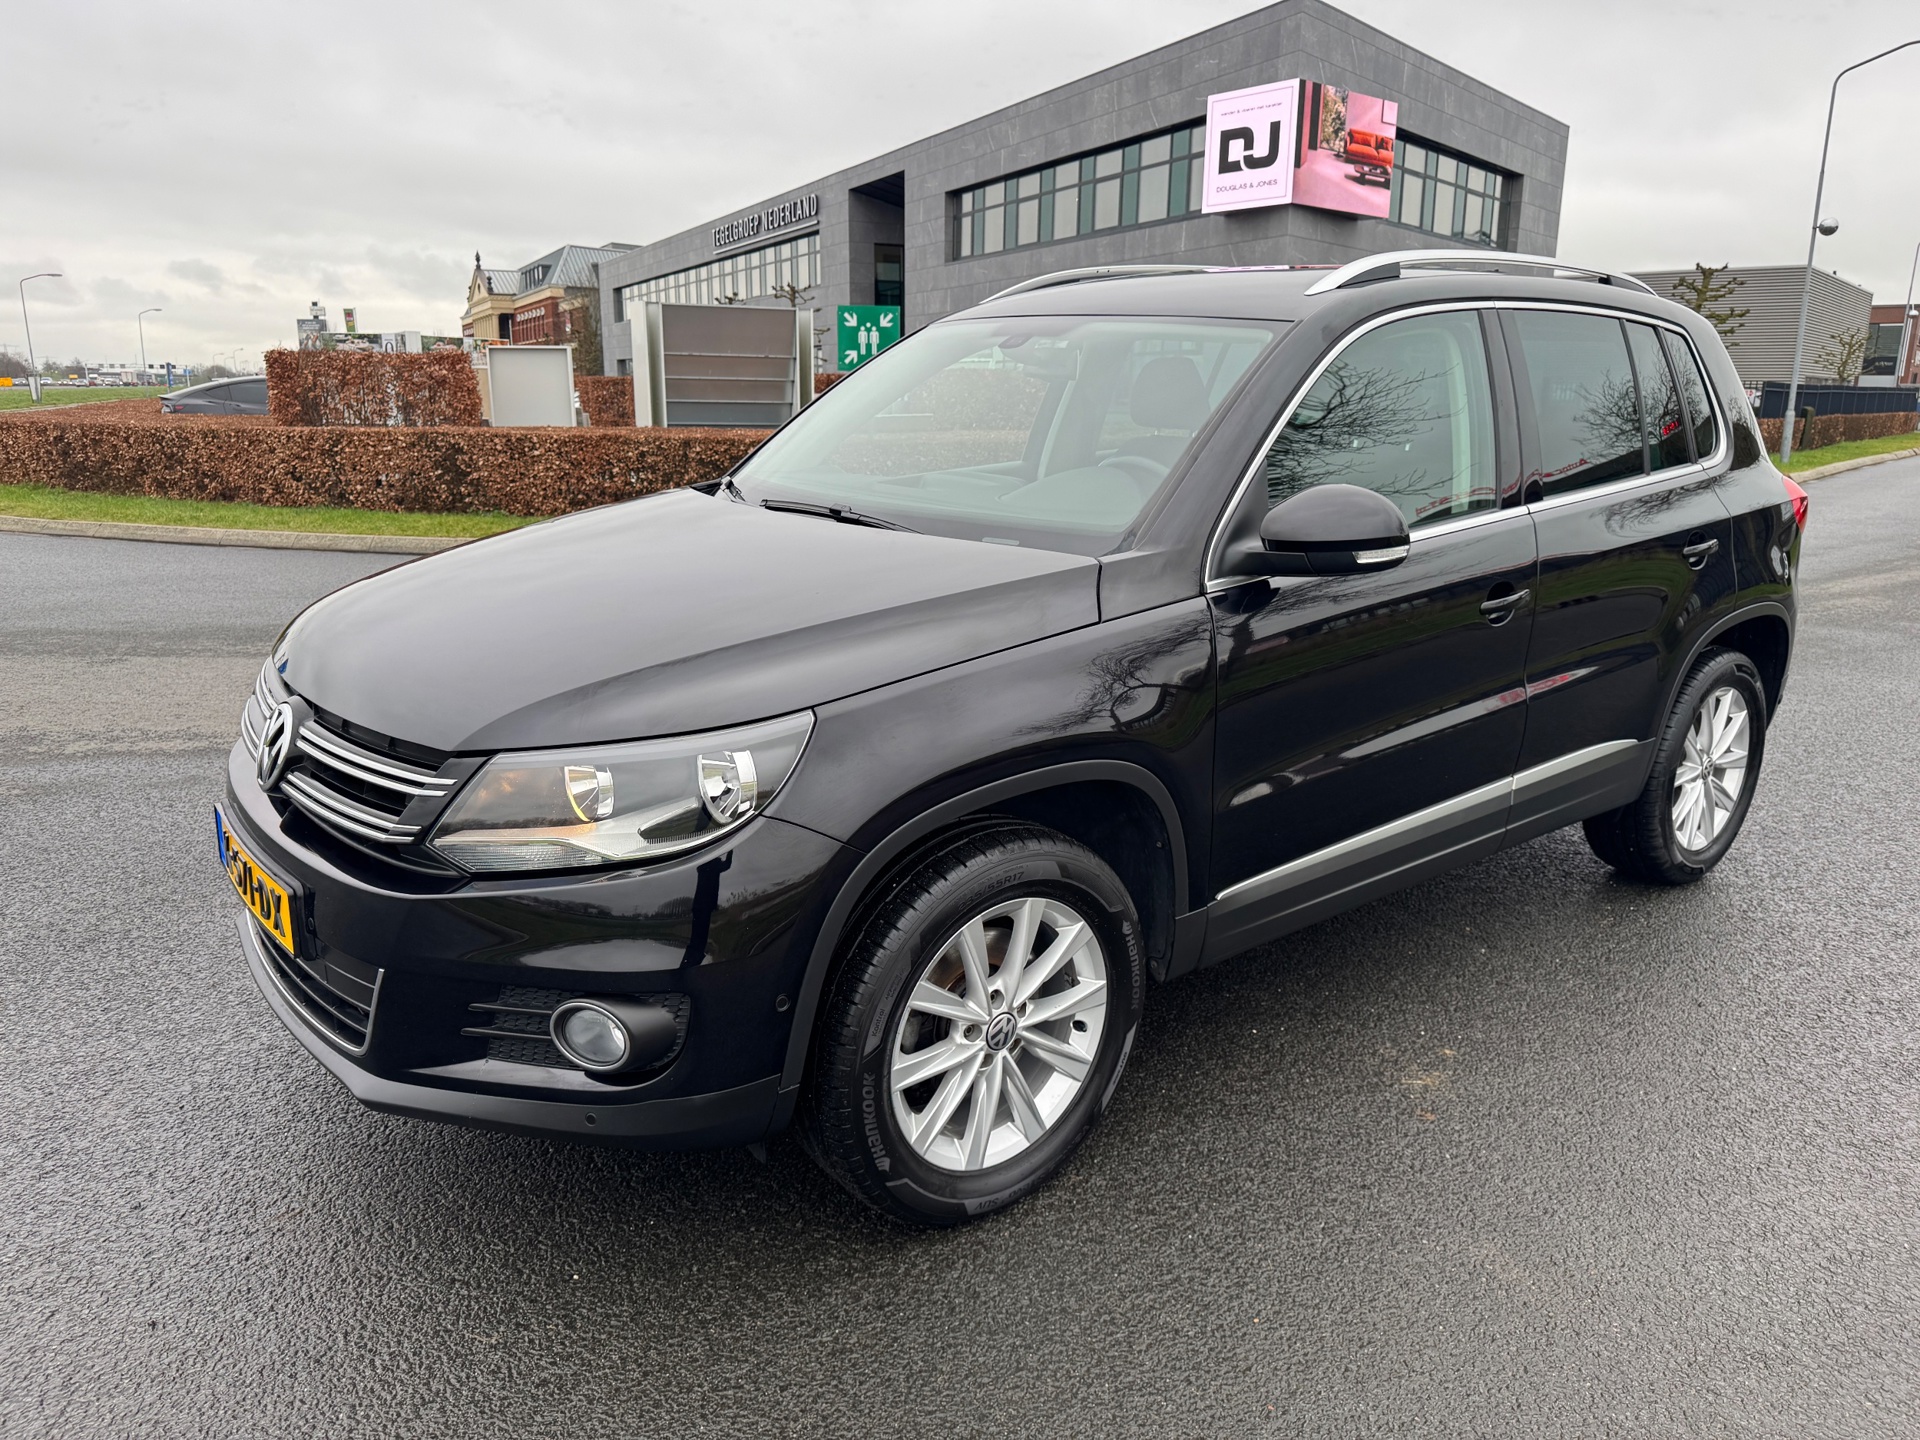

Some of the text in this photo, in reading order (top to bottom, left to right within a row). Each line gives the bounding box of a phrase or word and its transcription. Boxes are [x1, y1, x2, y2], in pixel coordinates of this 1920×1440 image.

[1216, 182, 1248, 193] DOUGLAS
[1256, 178, 1278, 188] JONES
[711, 193, 818, 247] TEGELGROEP NEDERLAND
